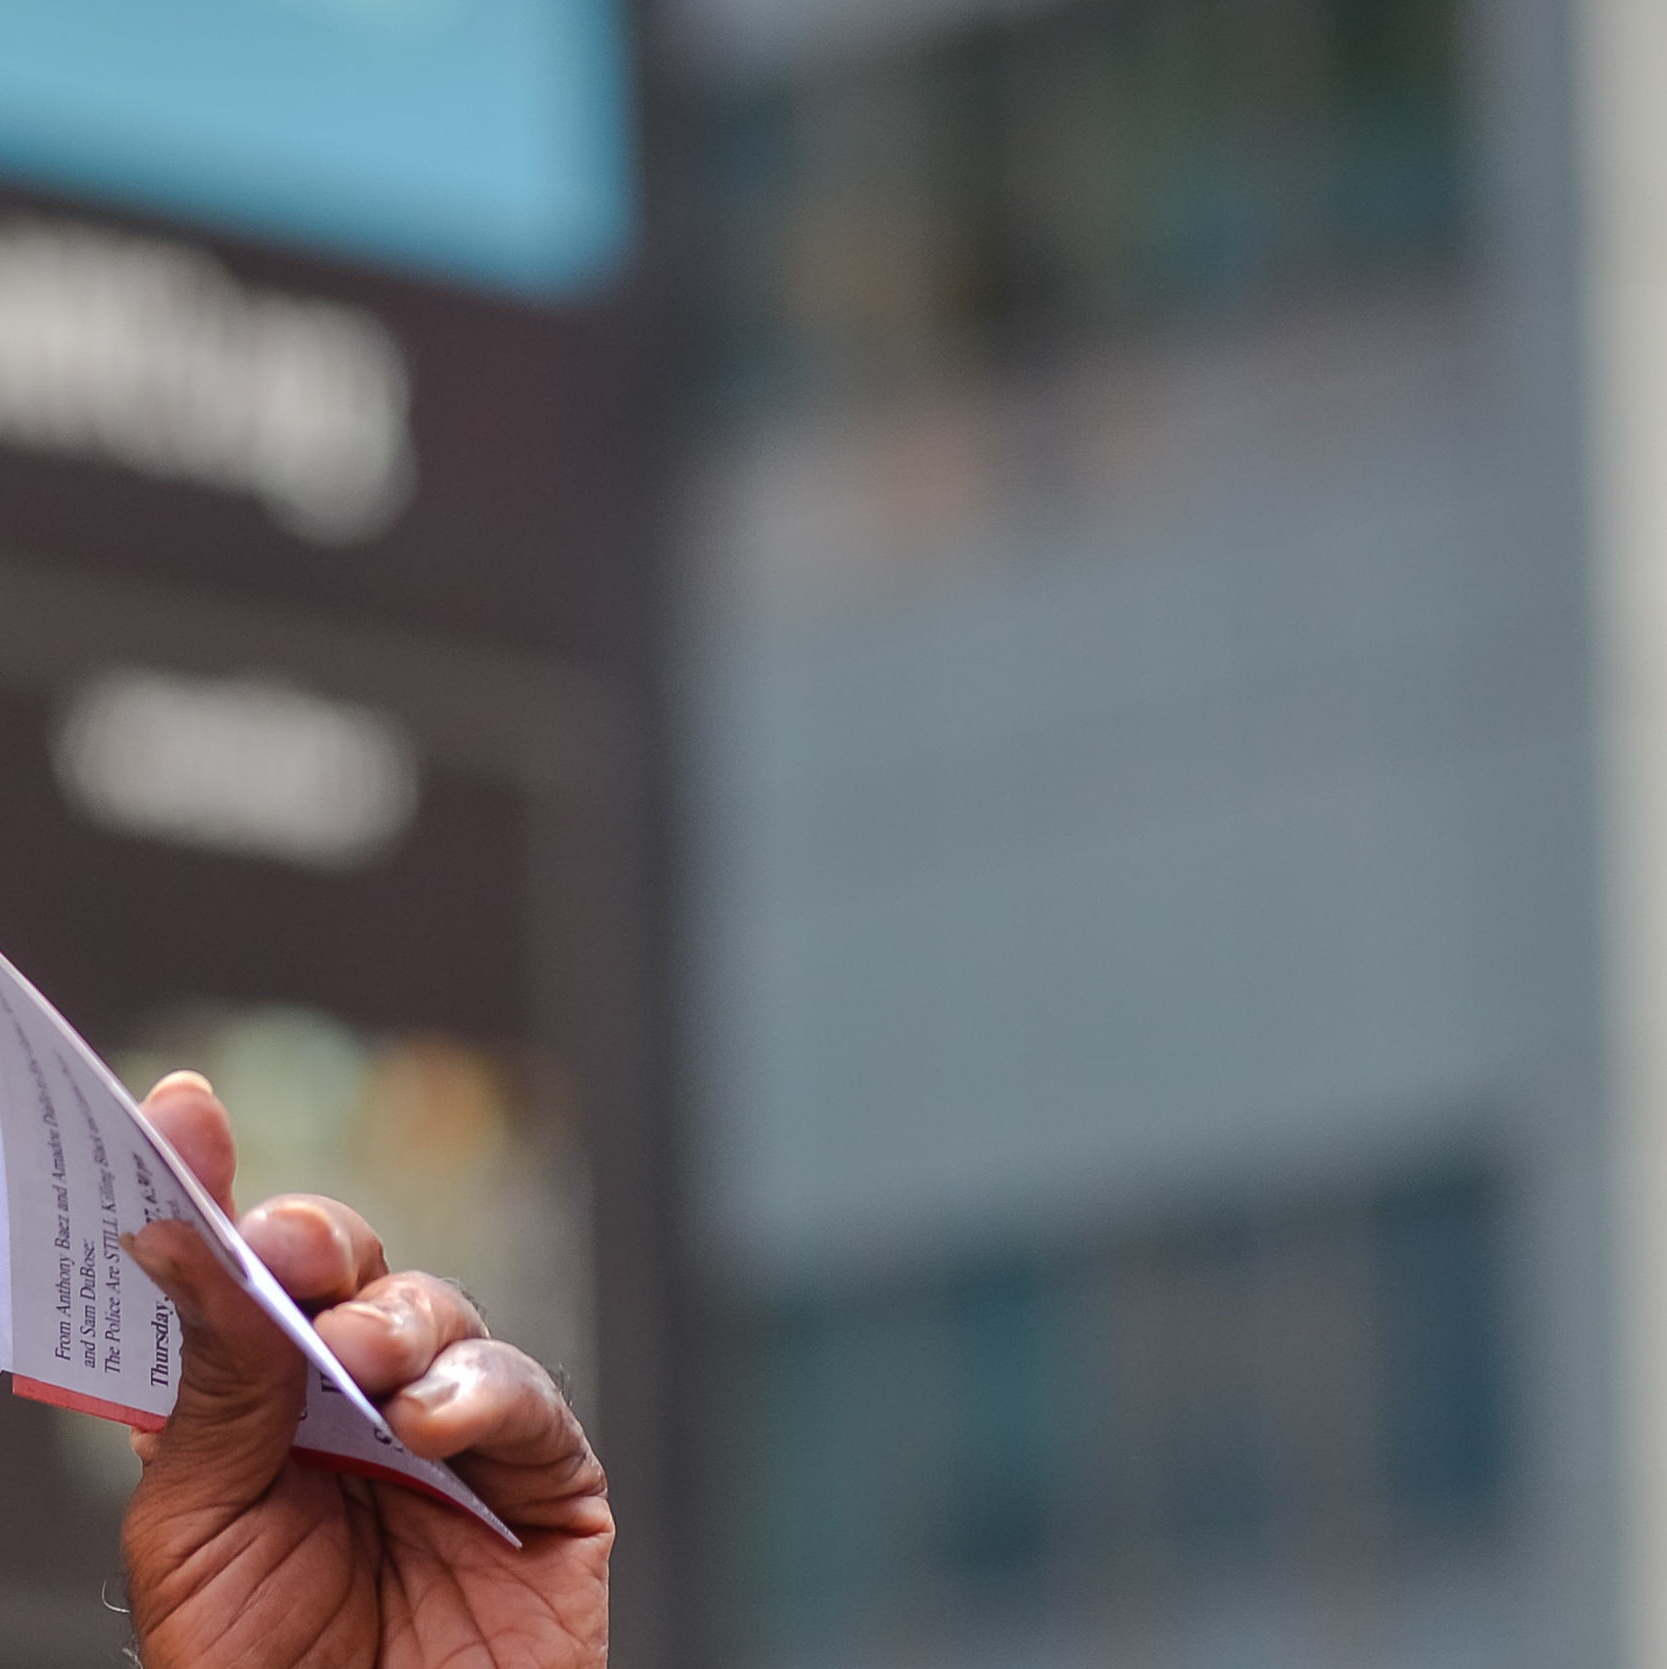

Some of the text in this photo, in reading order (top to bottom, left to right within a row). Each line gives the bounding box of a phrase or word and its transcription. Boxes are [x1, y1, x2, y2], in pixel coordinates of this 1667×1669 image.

[52, 1184, 69, 1213] and
[97, 1169, 116, 1211] Killing
[55, 1214, 71, 1250] Baez
[102, 1218, 120, 1262] STILL
[56, 1256, 75, 1317] Anthony
[105, 1265, 121, 1294] Are
[80, 1305, 96, 1340] Sam
[104, 1296, 121, 1344] Police
[55, 1321, 72, 1361] From
[83, 1341, 96, 1369] and
[104, 1346, 121, 1374] The
[150, 1296, 174, 1388] Thursday,
